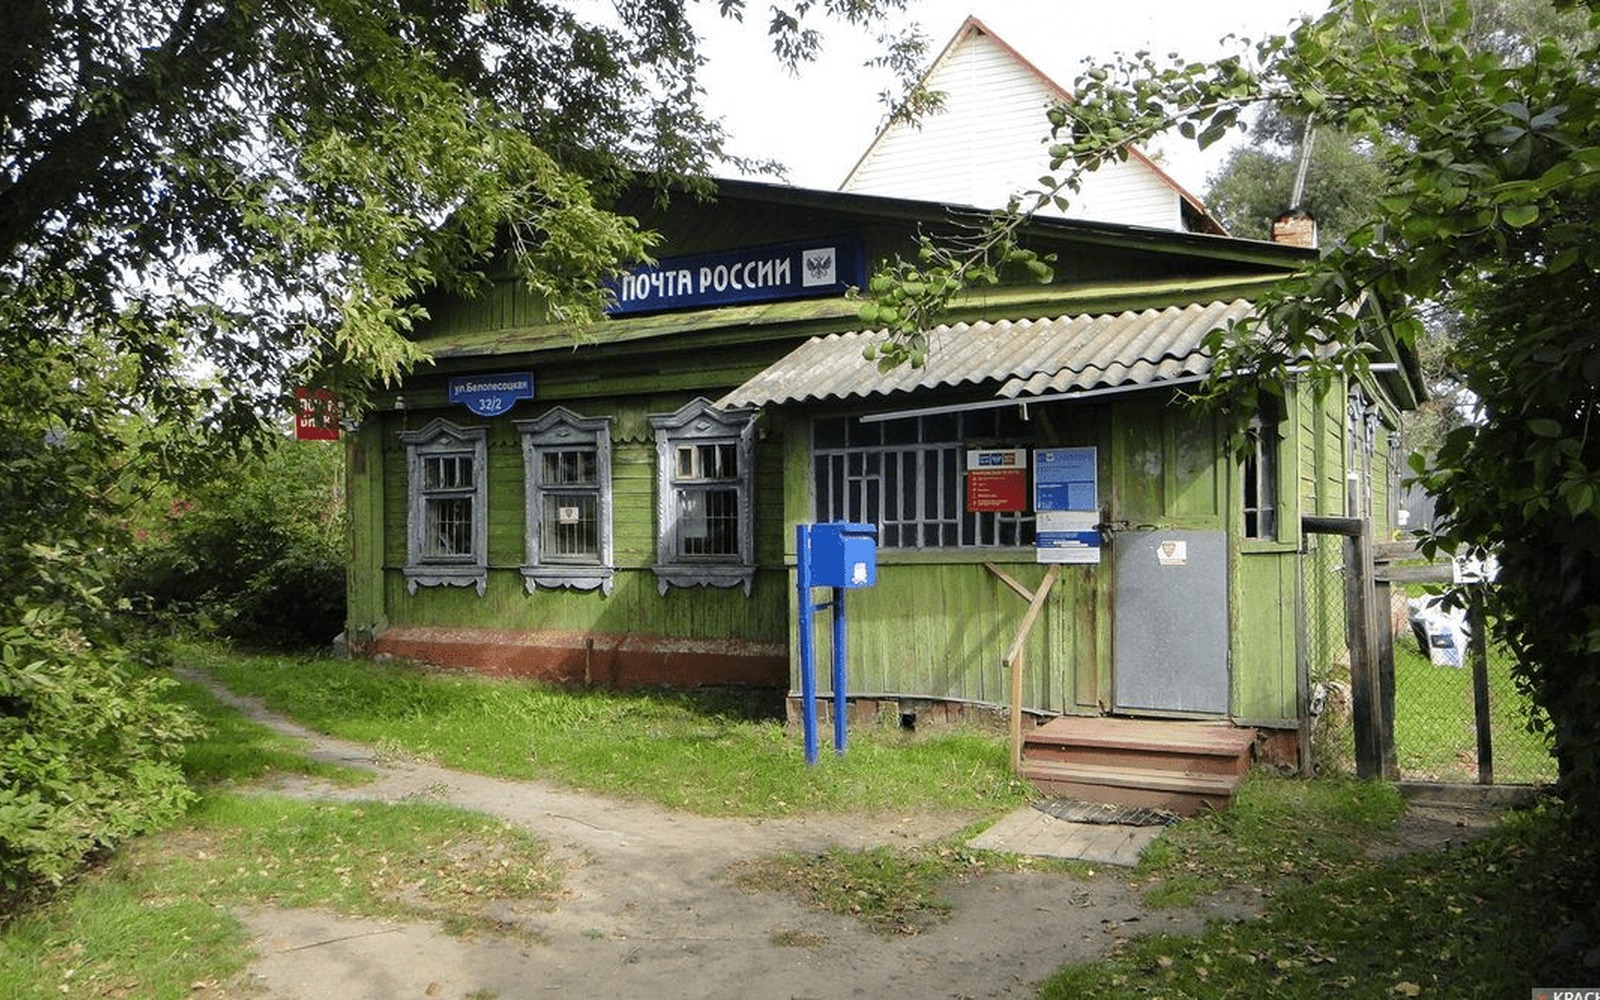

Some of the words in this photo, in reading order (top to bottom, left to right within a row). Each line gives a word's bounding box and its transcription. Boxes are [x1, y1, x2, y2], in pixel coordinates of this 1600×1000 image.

[622, 269, 692, 301] ПОЧТА
[699, 257, 791, 294] РОССИИ
[478, 396, 502, 413] 32/2
